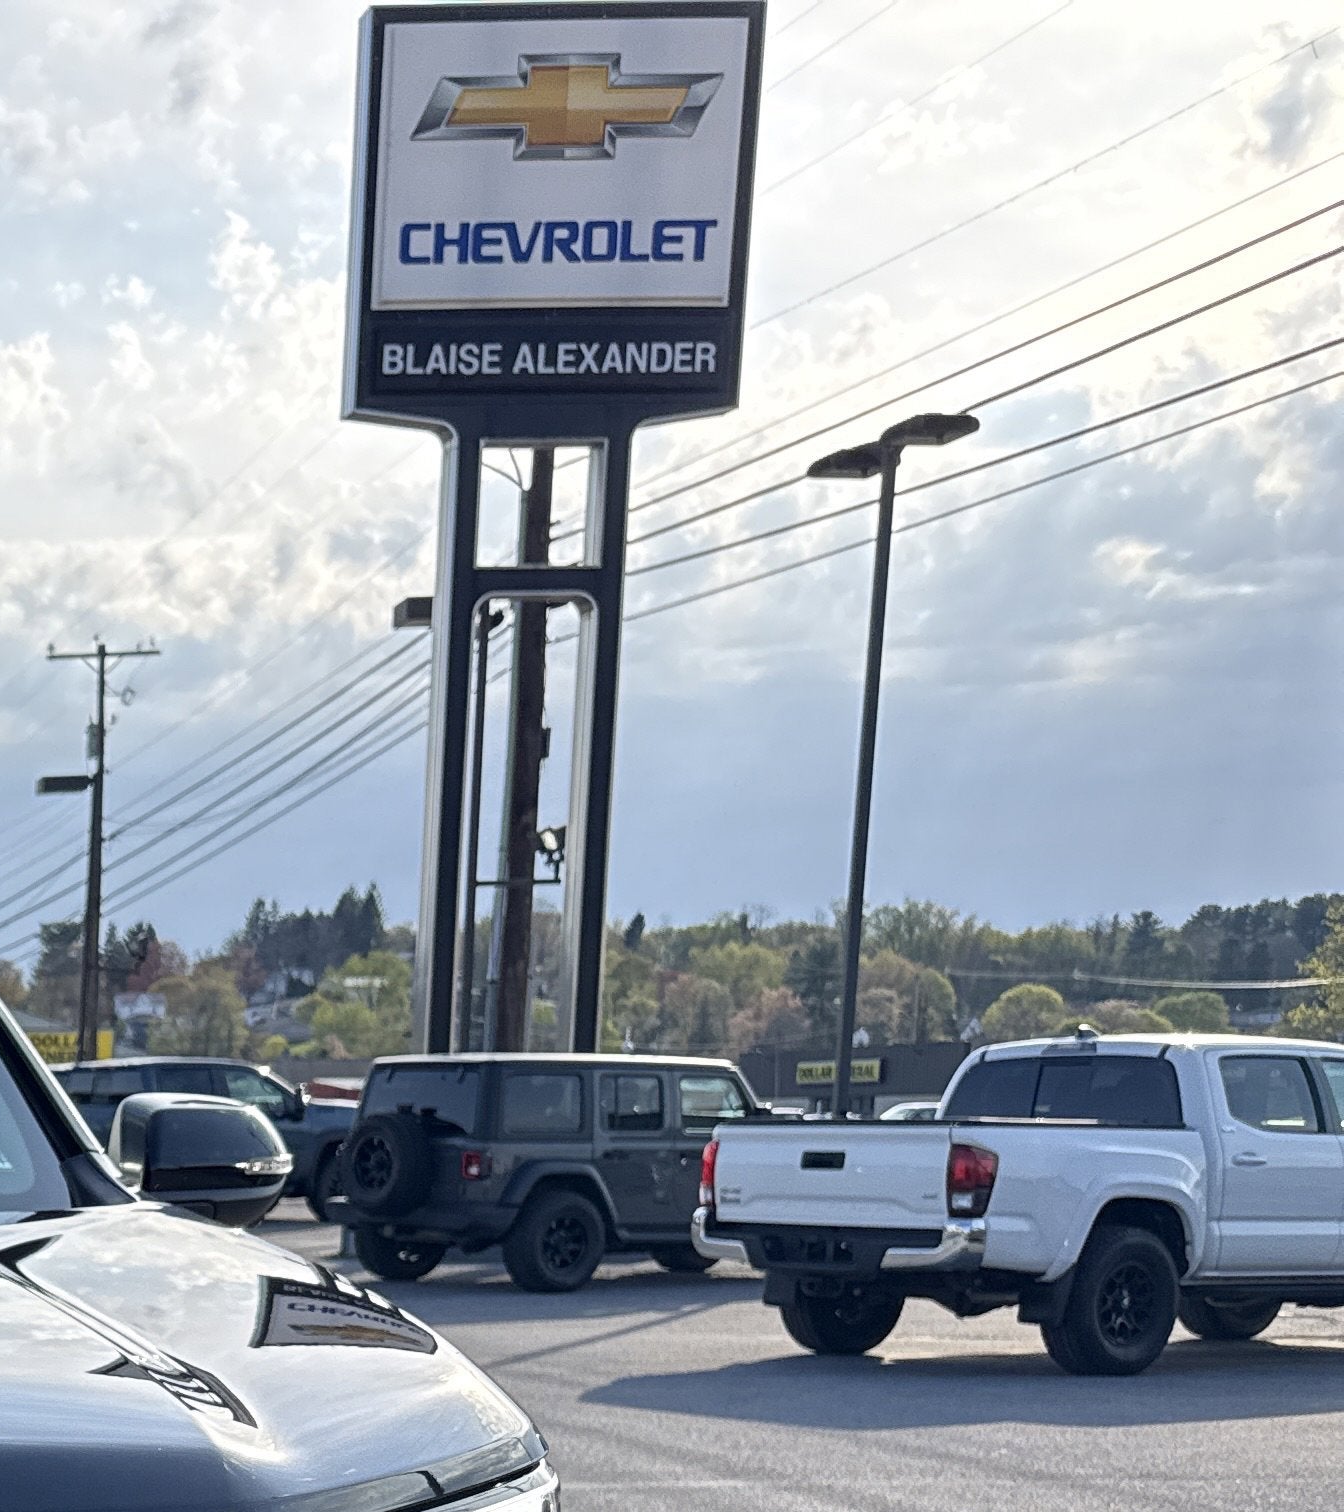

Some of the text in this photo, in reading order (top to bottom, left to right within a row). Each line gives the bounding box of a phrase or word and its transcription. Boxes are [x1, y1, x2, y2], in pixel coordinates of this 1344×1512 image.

[398, 219, 718, 265] CHEVROLET
[381, 341, 716, 377] BLAISE ALEXANDER
